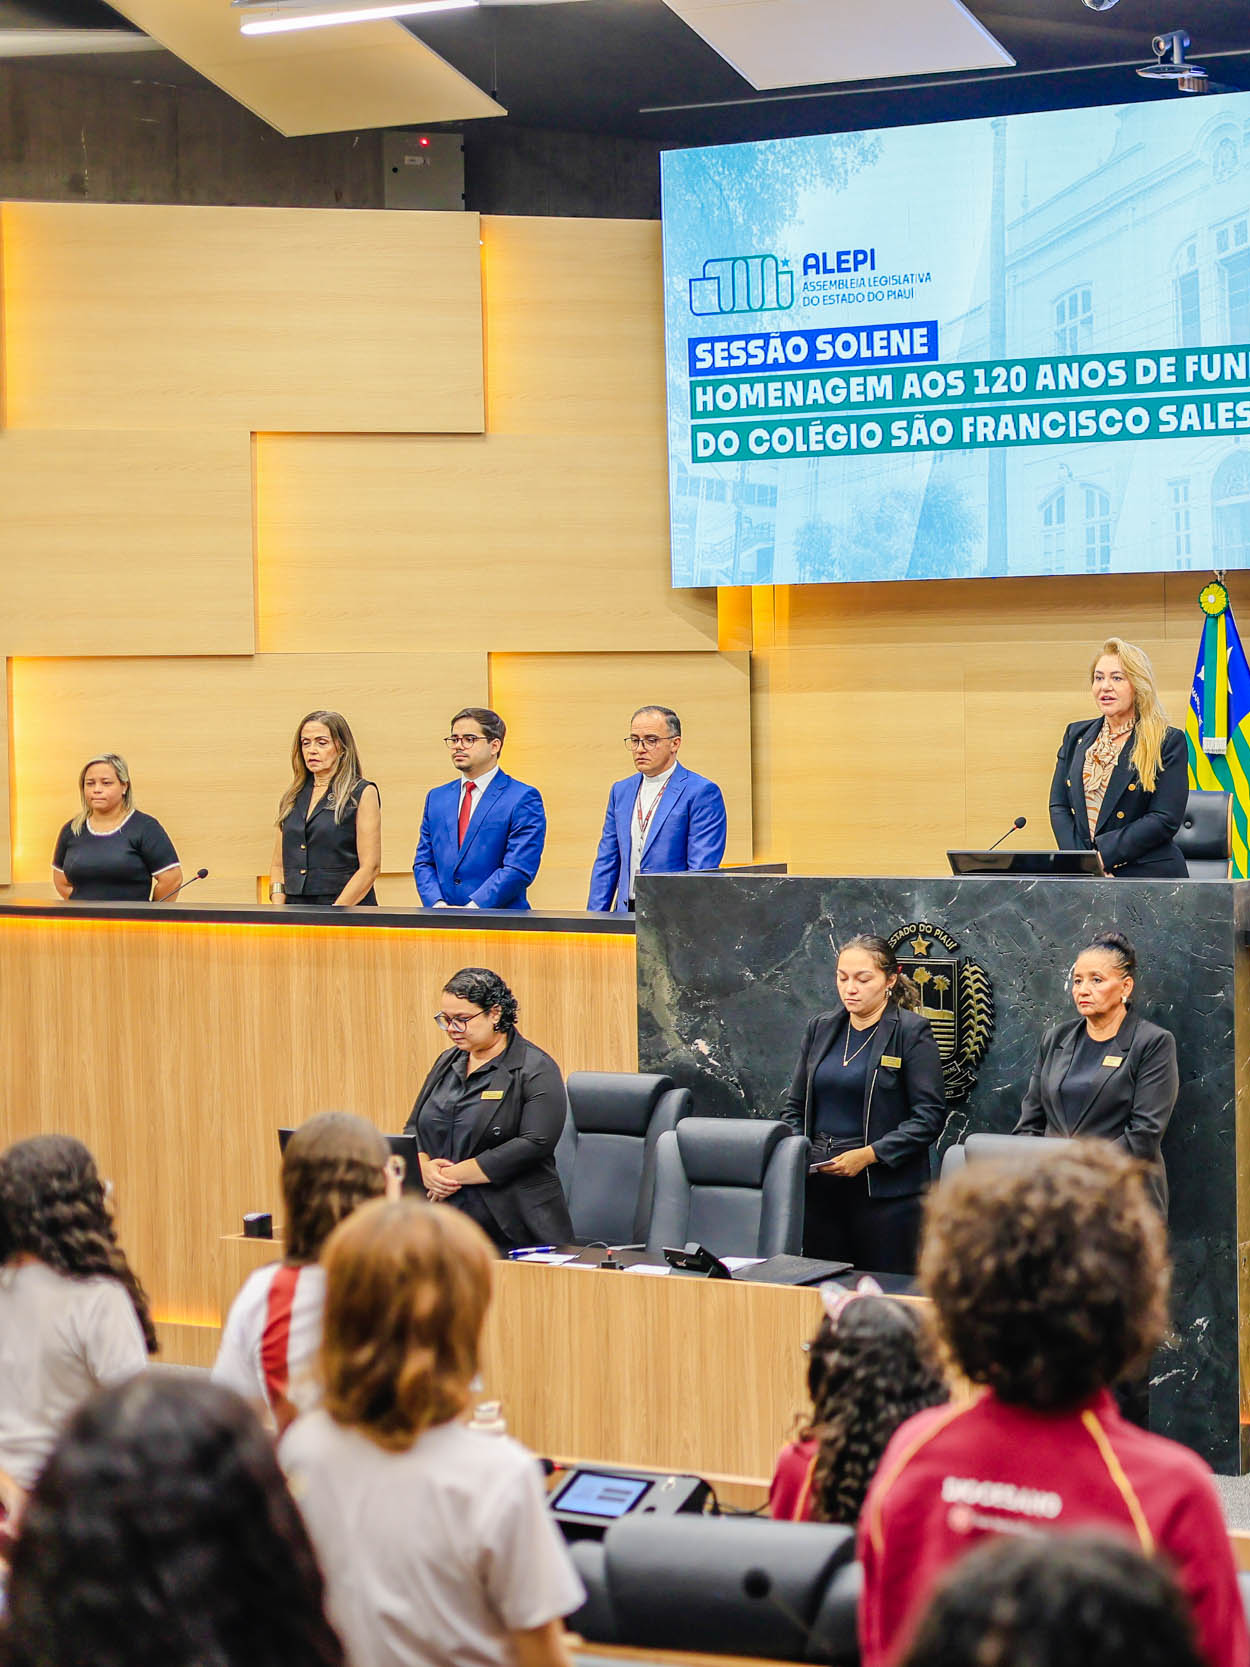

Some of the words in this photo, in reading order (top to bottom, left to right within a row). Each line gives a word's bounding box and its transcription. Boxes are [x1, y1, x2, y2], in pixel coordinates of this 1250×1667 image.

[803, 248, 875, 276] ALEPI
[802, 277, 866, 292] ASSEMBLEIA
[868, 272, 931, 287] LEGISLATIVA
[803, 296, 820, 307] DO
[822, 292, 865, 306] ESTADO
[868, 290, 885, 302] DO
[695, 332, 808, 369] SESSÃO
[816, 327, 928, 361] SOLENE
[695, 375, 893, 412] HOMENAGEM
[902, 370, 965, 399] AOS
[974, 365, 1027, 395] 120
[1036, 359, 1127, 391] ANOS
[1135, 357, 1176, 385] DE
[696, 430, 740, 457] DO
[748, 421, 883, 452] COLÉGIO
[891, 415, 953, 447] SÃO
[962, 408, 1150, 442] FRANCISCO
[919, 924, 932, 933] DO
[934, 929, 957, 950] PIAUÍ
